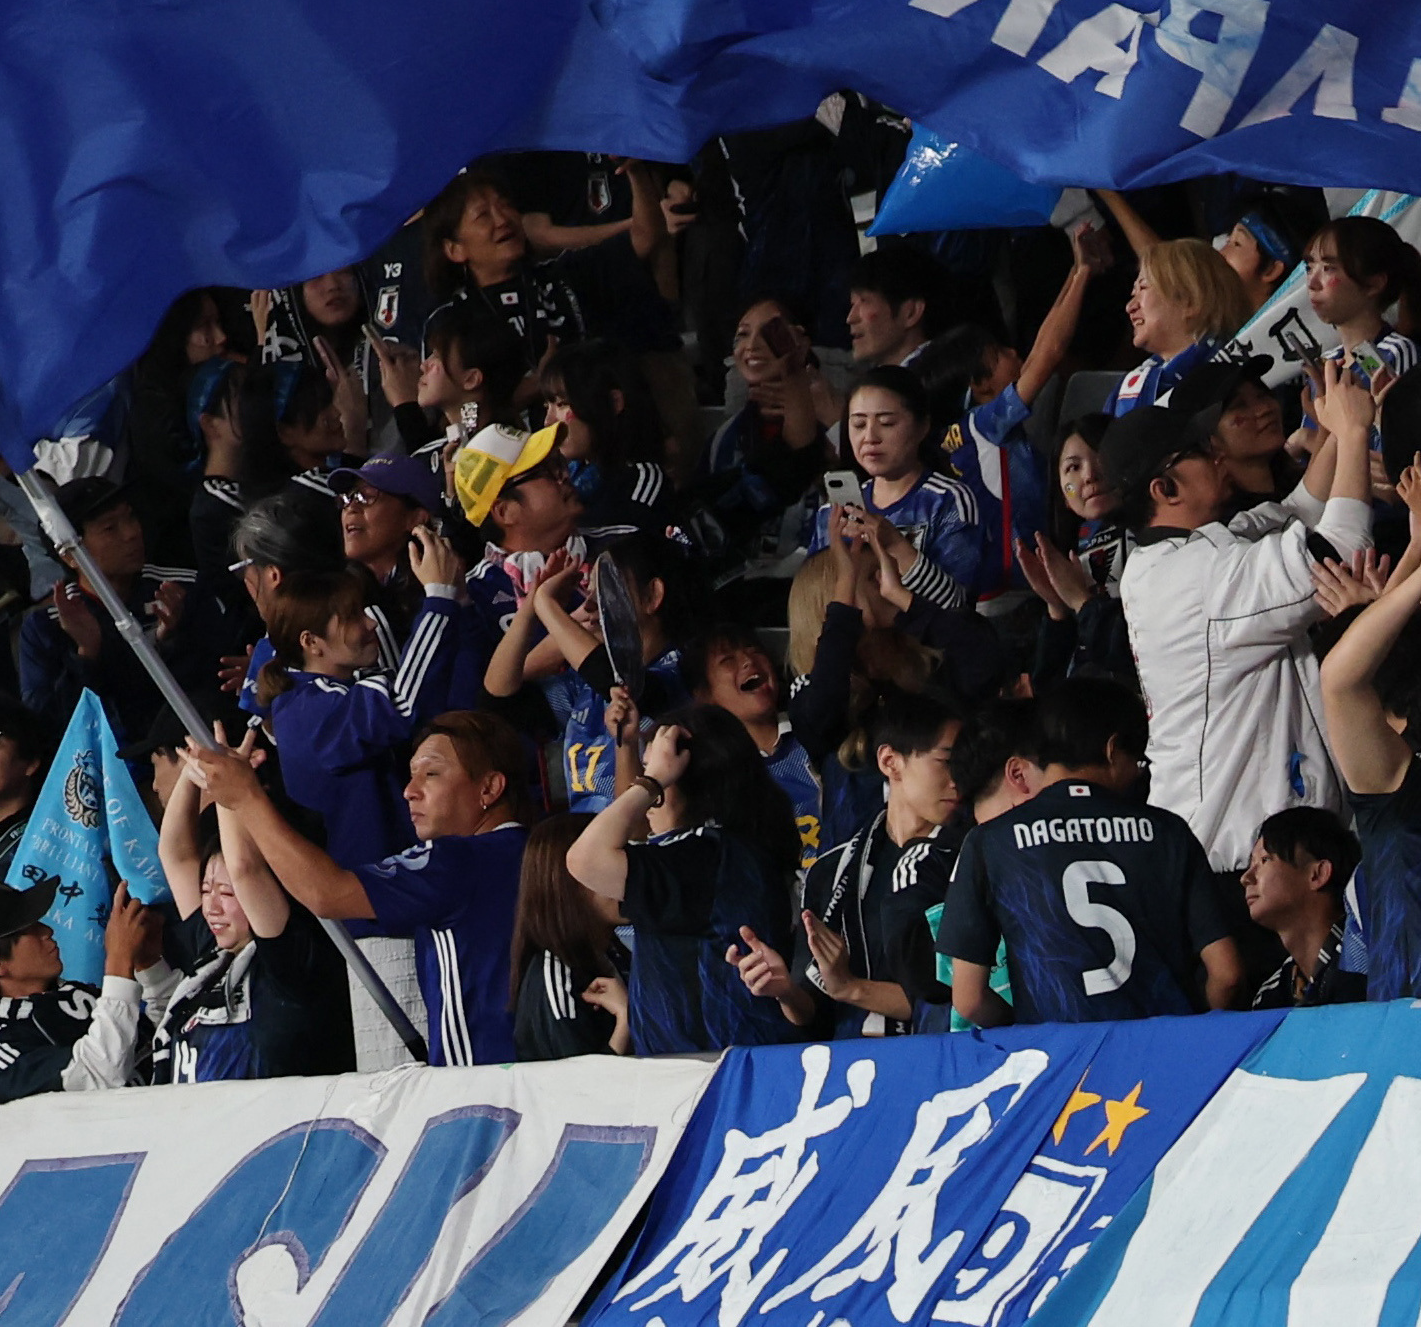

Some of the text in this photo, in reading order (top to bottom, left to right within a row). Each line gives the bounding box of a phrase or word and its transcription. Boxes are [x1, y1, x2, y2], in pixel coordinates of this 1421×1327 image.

[568, 743, 607, 793] 17
[1014, 817, 1155, 850] NAGATOMO
[1061, 860, 1136, 996] 5
